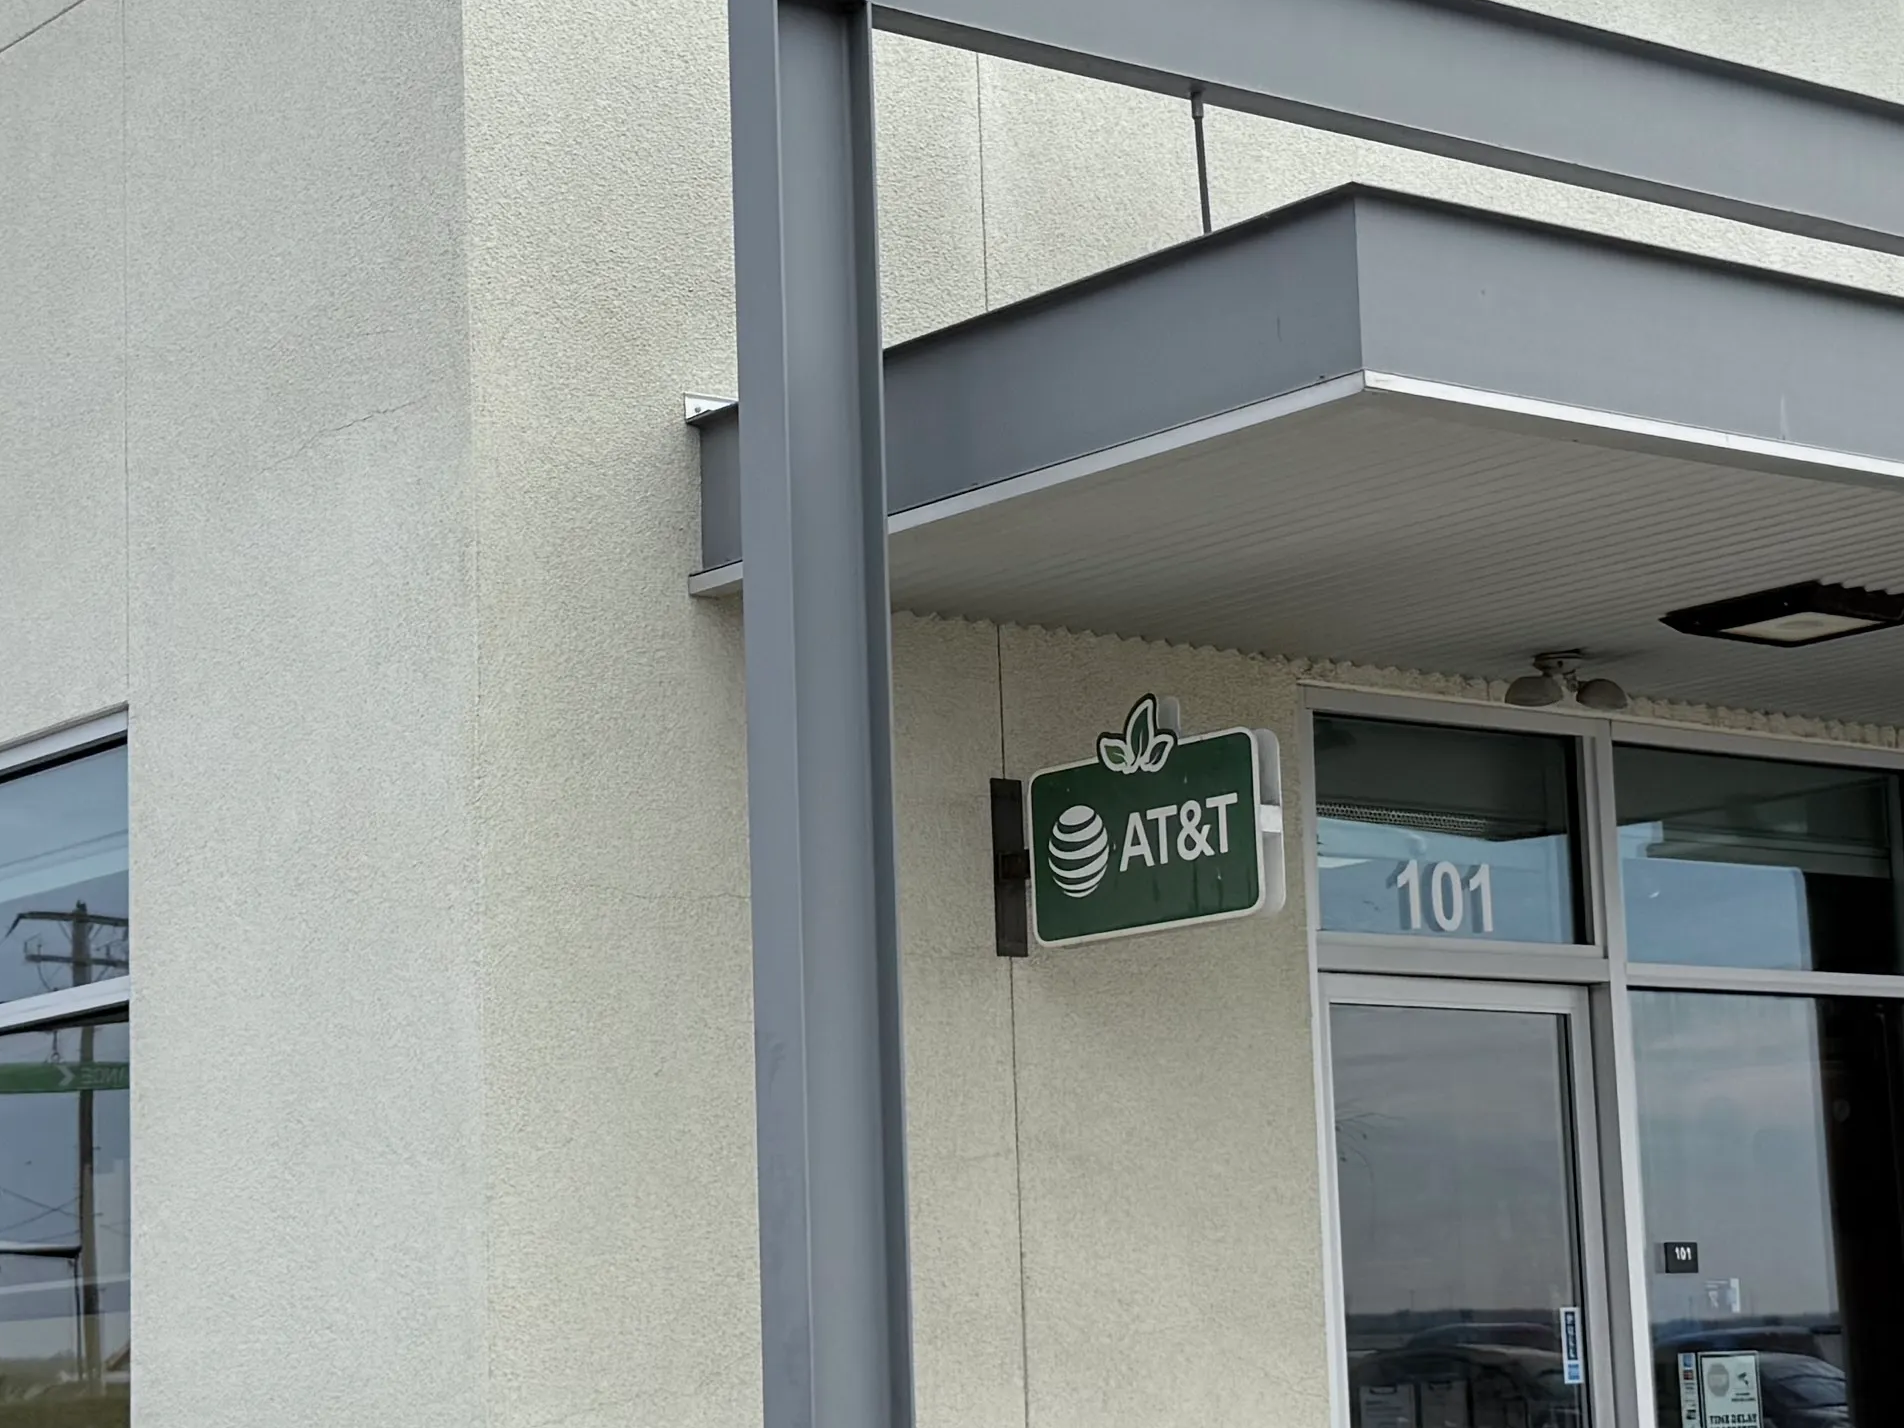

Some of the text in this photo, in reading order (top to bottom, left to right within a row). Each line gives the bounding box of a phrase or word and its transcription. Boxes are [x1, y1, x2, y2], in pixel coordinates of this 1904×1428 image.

[1119, 792, 1238, 872] AT&T
[1395, 860, 1494, 933] 101
[1675, 1246, 1692, 1261] 101
